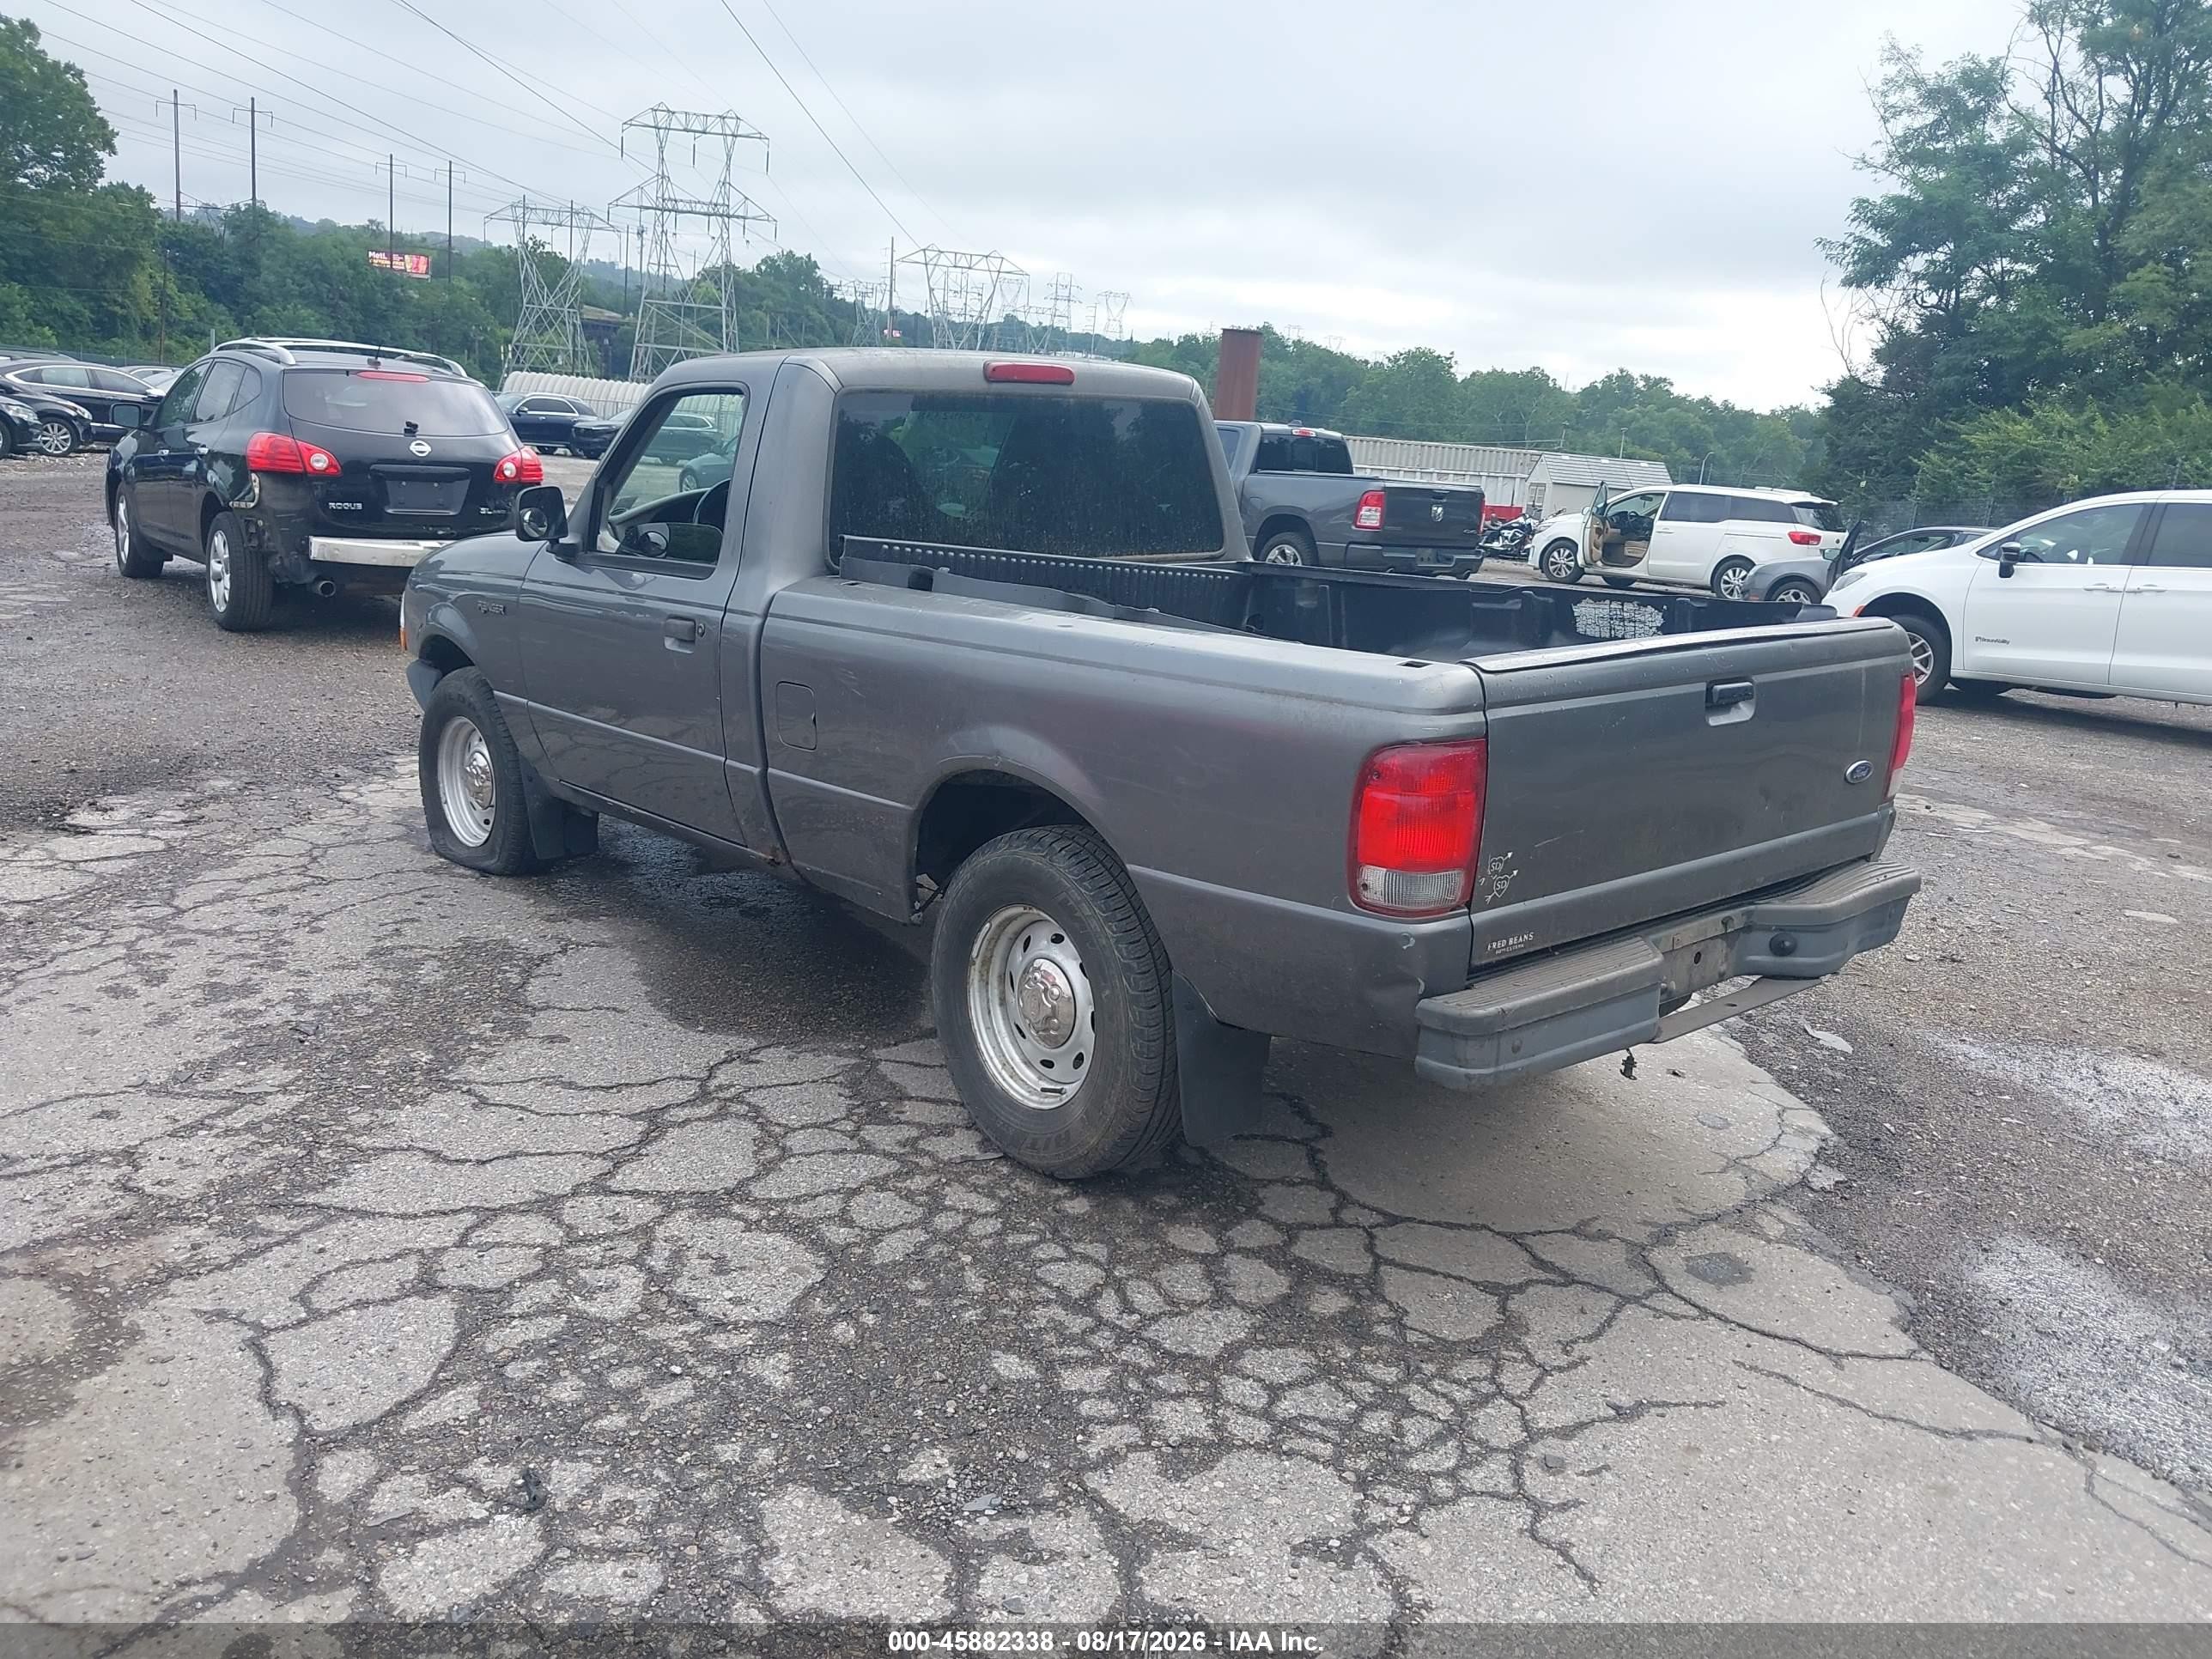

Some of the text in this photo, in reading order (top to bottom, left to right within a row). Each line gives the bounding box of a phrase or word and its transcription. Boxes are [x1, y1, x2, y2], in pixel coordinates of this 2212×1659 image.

[1490, 861, 1501, 872] SD
[1495, 880, 1507, 890] SD
[1487, 932, 1534, 951] FRED BEANS
